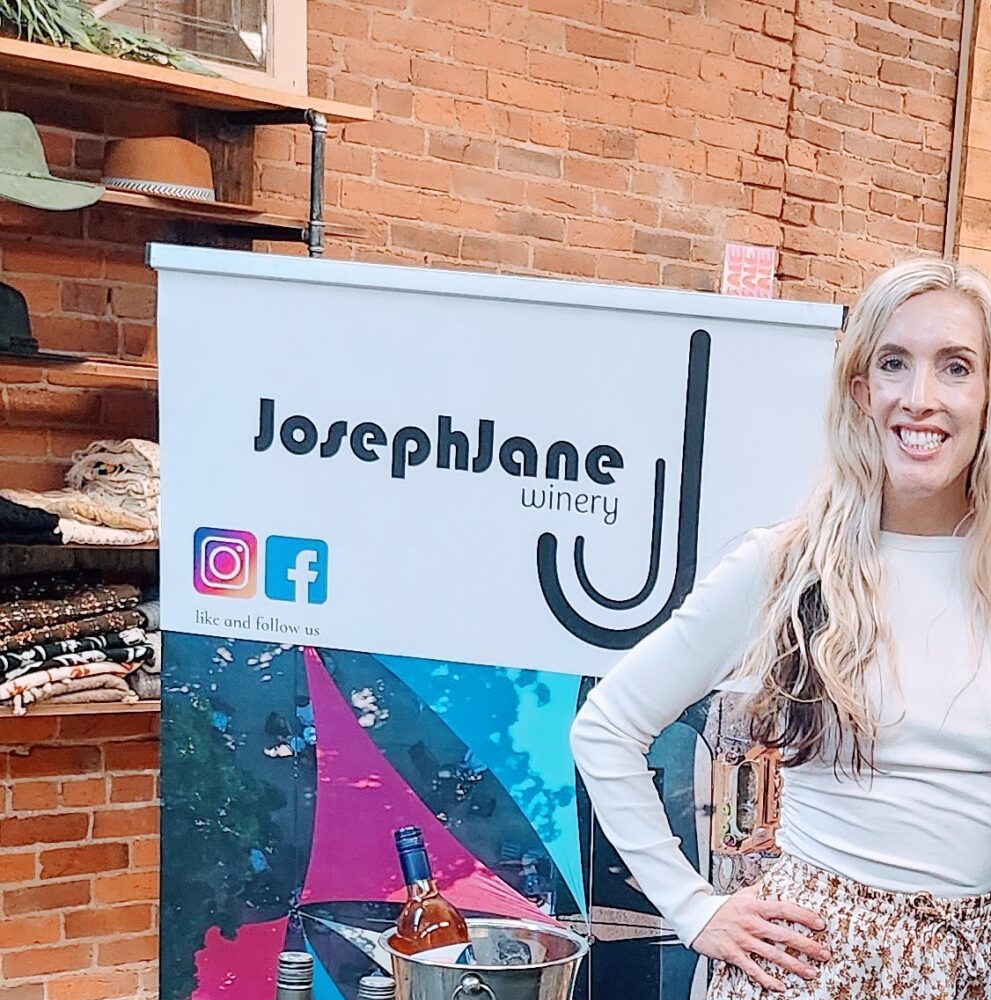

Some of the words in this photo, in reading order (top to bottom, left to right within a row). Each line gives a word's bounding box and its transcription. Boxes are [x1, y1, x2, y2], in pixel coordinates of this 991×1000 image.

[254, 398, 624, 485] JosephJane
[521, 484, 619, 525] winery
[195, 609, 220, 626] like
[224, 615, 251, 629] and
[256, 616, 300, 634] follow
[305, 627, 320, 636] us
